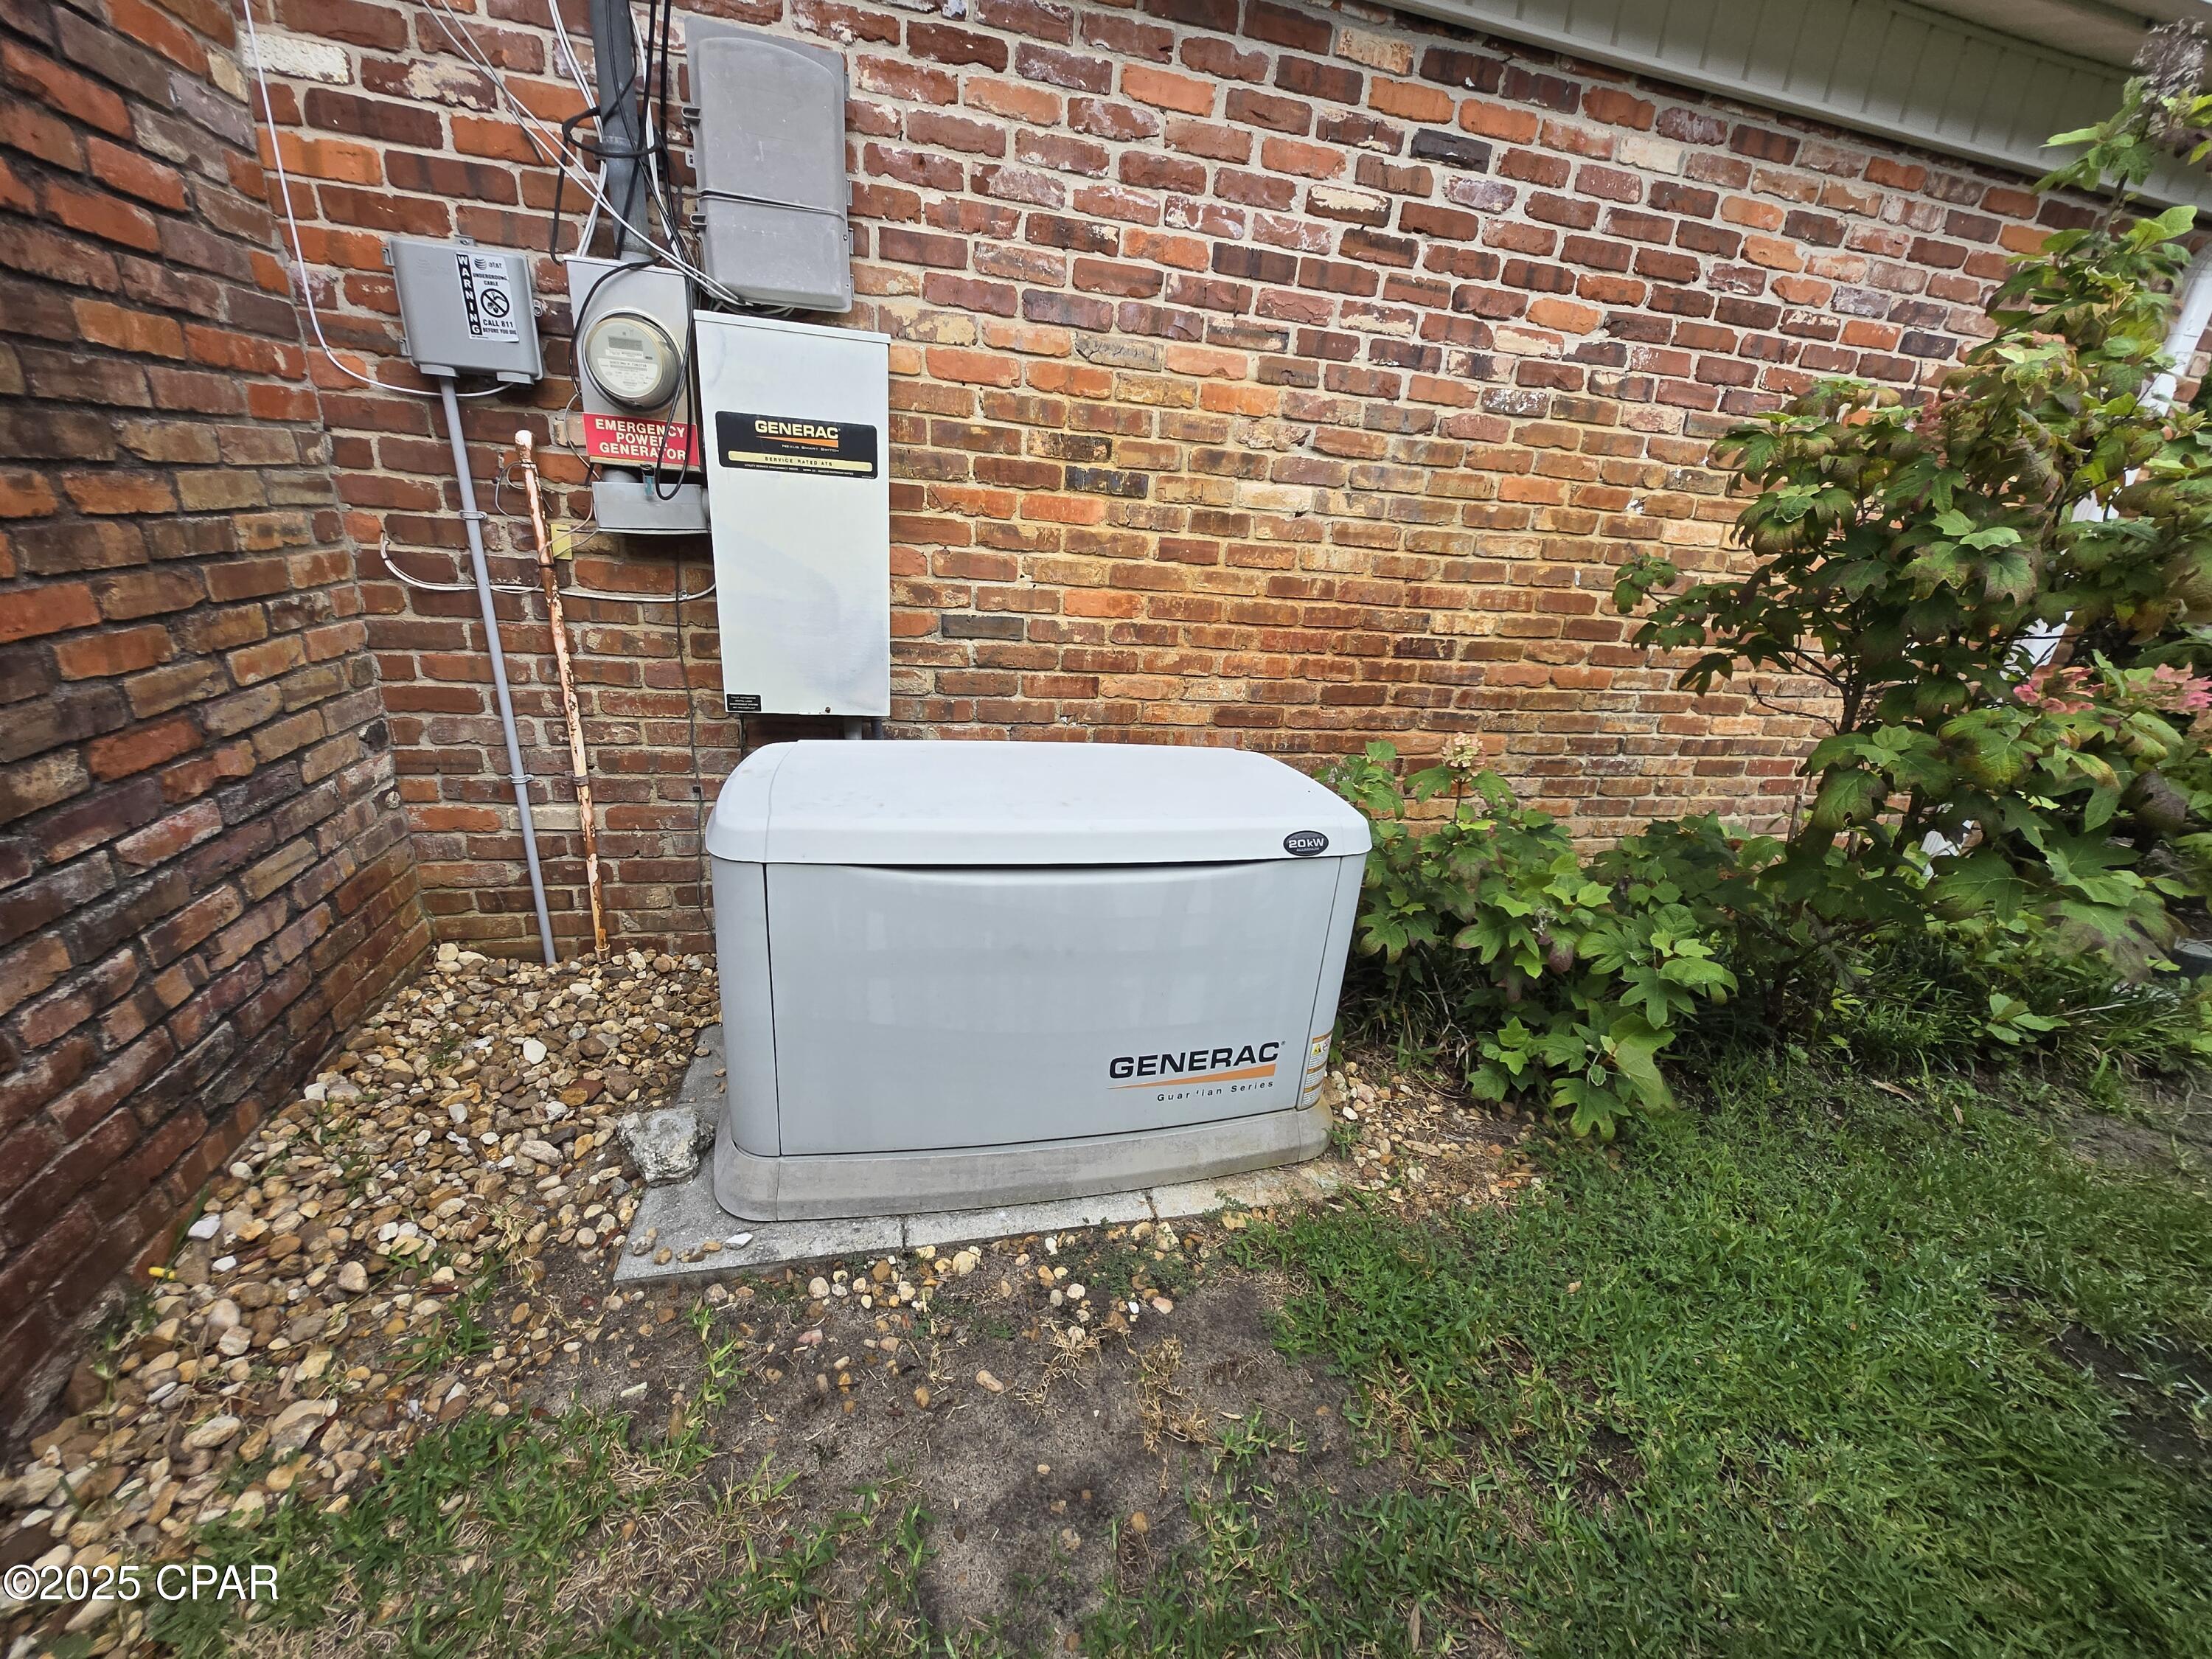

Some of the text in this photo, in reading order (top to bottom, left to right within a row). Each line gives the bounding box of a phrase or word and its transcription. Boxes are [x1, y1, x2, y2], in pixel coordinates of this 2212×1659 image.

[457, 255, 481, 334] WARNING
[595, 418, 685, 438] EMERGENCY
[754, 420, 839, 439] GENERAC
[1109, 1041, 1279, 1079] GENERAC
[1157, 1081, 1274, 1102] Guarian Series
